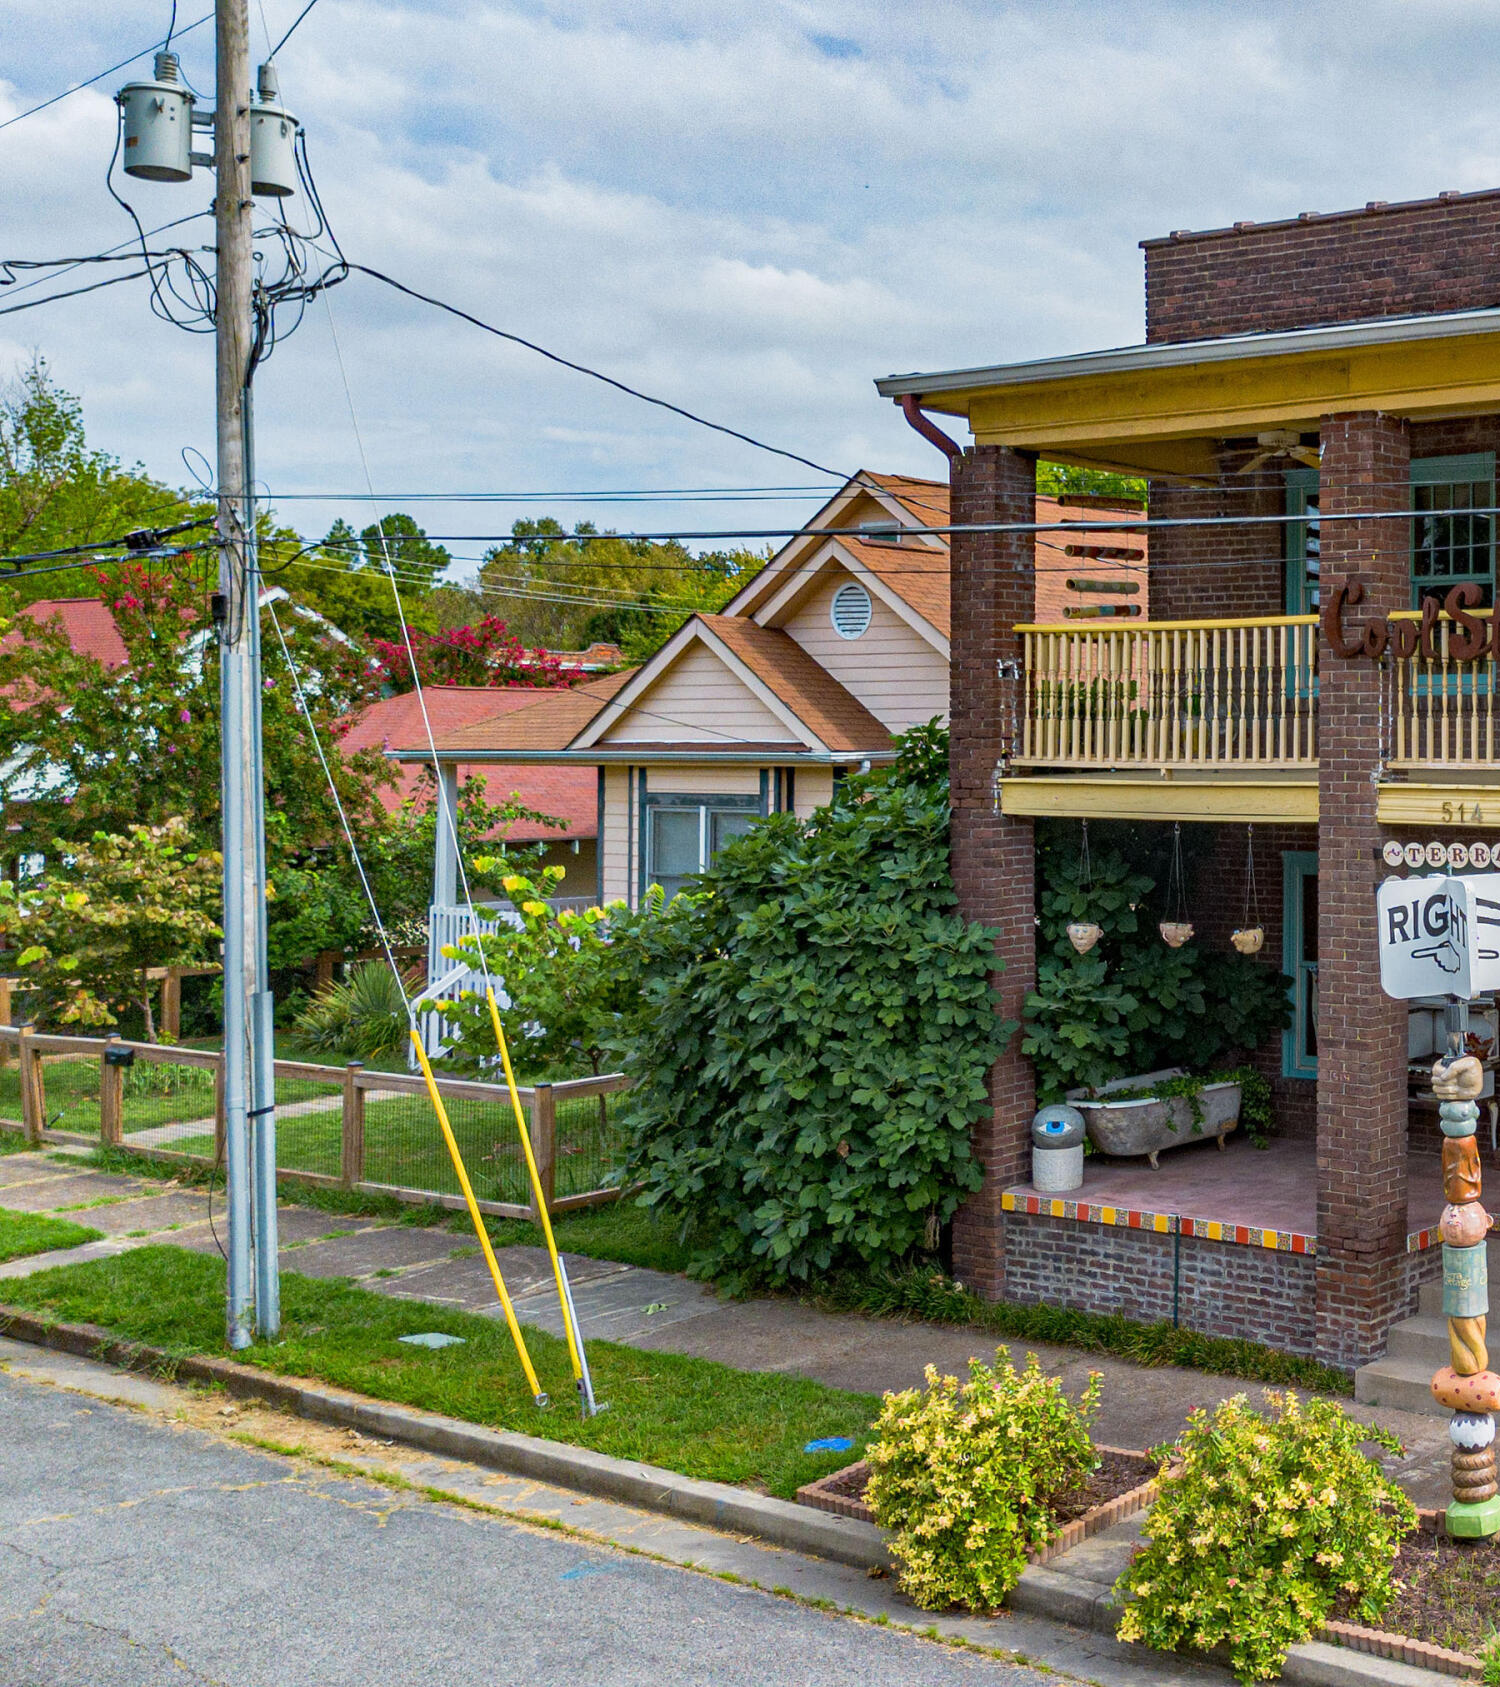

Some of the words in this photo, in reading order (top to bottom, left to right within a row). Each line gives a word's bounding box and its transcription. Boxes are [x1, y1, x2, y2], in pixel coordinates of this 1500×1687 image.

[1324, 581, 1440, 659] Cool
[1442, 801, 1483, 824] 514
[1387, 894, 1468, 948] RIGHT
